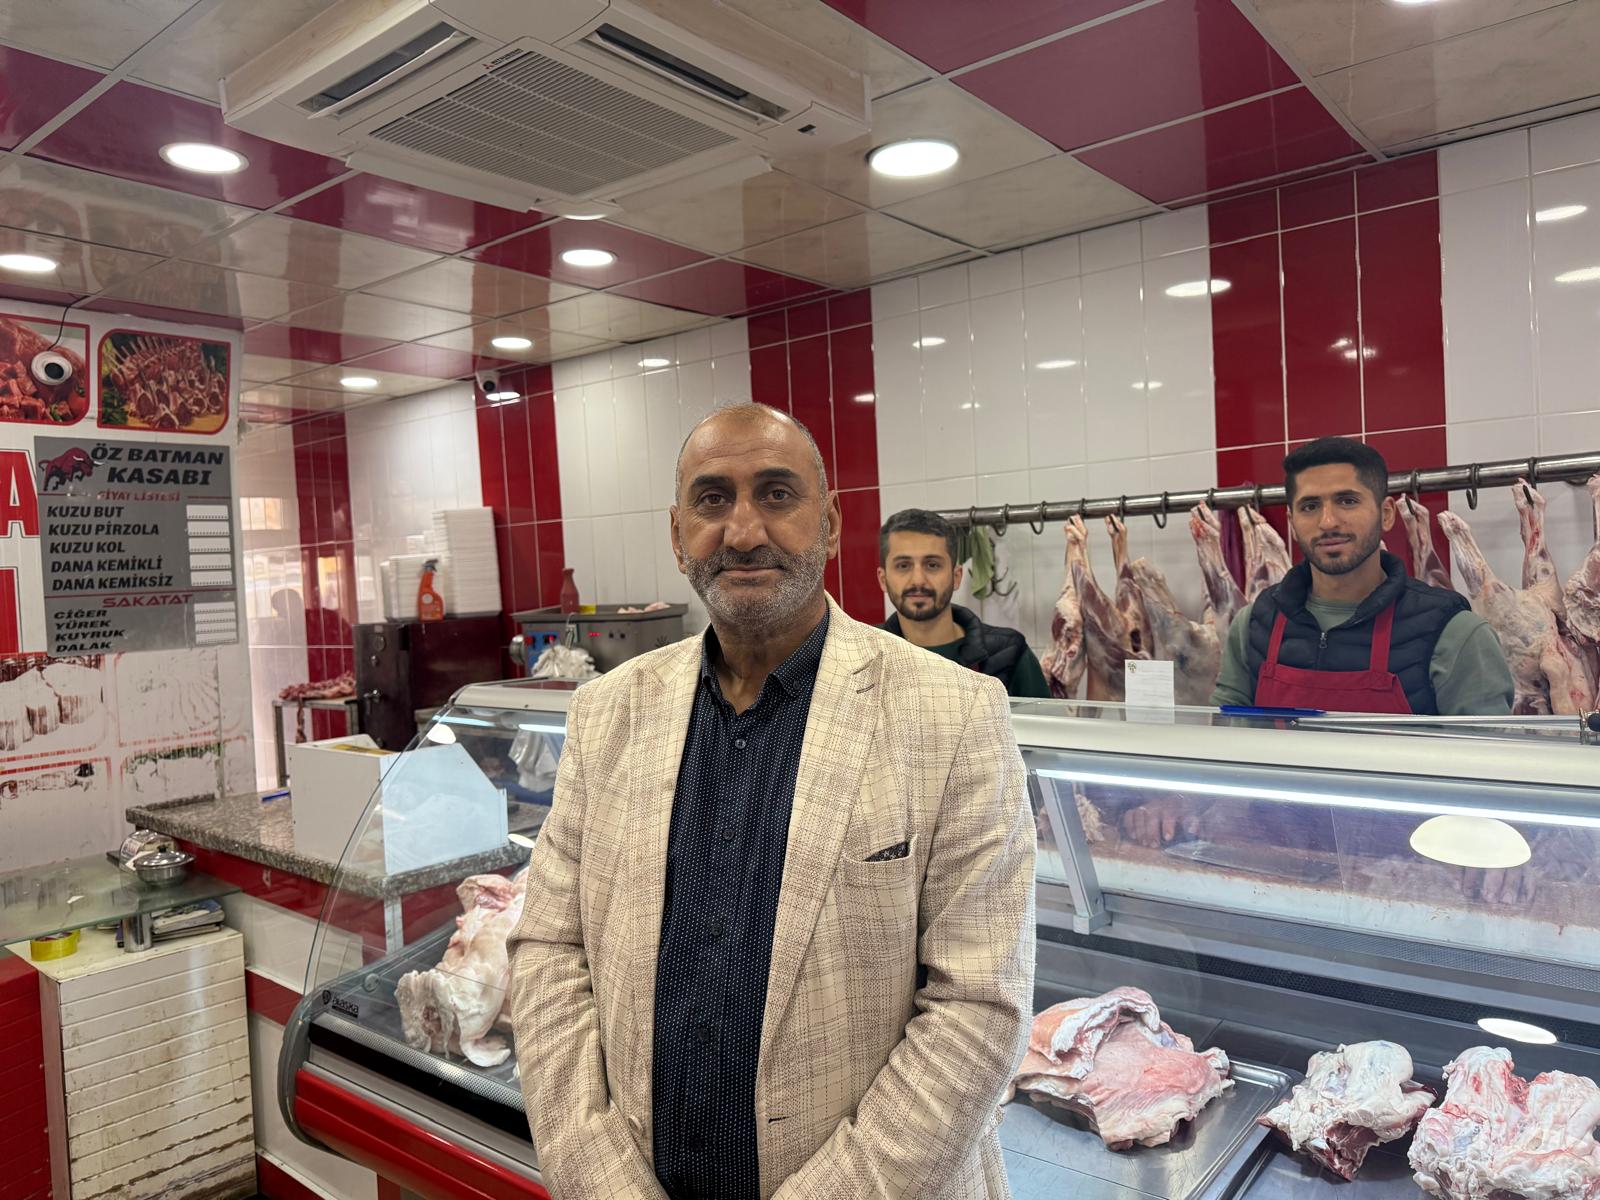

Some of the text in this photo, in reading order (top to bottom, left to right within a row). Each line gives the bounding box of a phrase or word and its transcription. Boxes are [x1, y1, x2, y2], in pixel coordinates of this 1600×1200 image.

[91, 443, 224, 465] ÖZ BATMAN
[107, 467, 212, 485] KASABI
[47, 506, 124, 518] KUZU BUT
[48, 521, 160, 536] KUZU PİRZOLA
[50, 541, 126, 554] KUZU KOL
[51, 555, 163, 573] DANA KEMİKLİ
[52, 575, 173, 591] DANA KEMİKSİZ
[102, 594, 193, 608] SAKATAT
[54, 609, 107, 619] CİĞER
[55, 620, 111, 630] YÜREK
[55, 629, 125, 641] KUYRUK
[56, 641, 112, 652] DALAK
